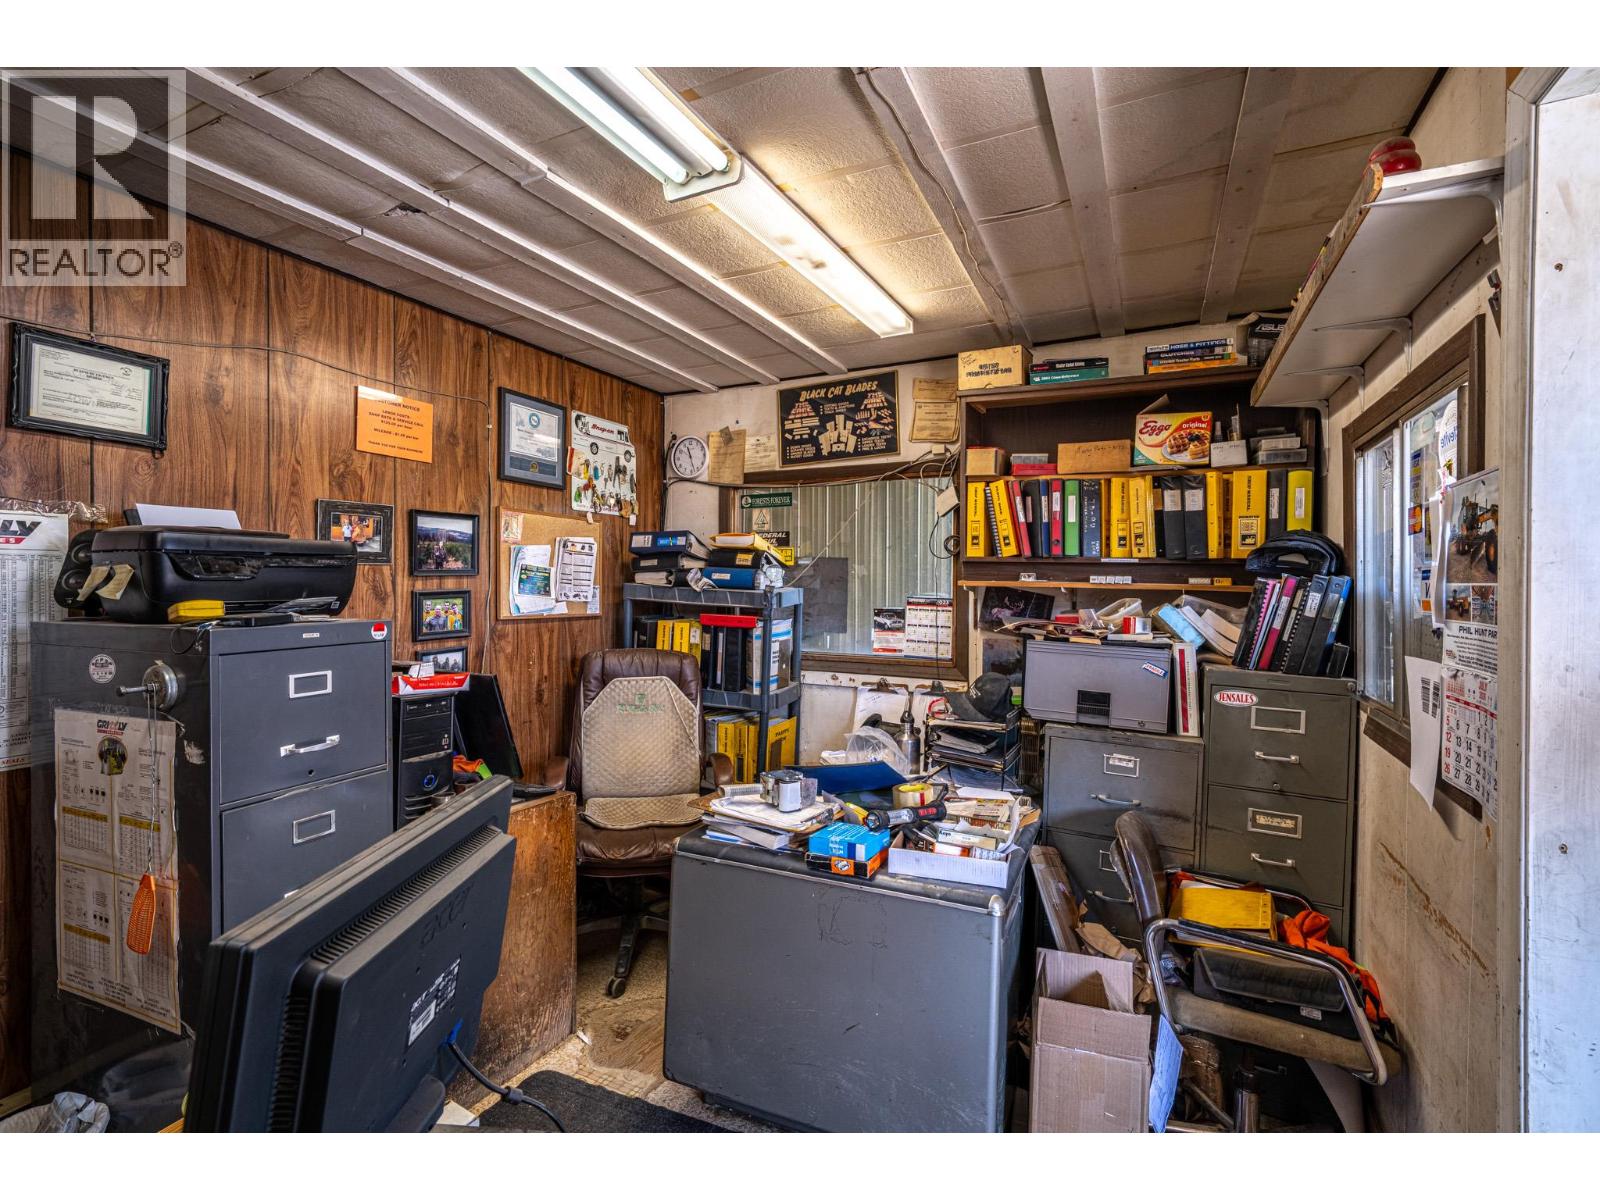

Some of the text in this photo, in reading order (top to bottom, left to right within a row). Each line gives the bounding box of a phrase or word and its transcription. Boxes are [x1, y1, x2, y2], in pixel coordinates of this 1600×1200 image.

[800, 381, 879, 401] BLACK CAT BLADES
[1139, 421, 1172, 436] Eggo
[1459, 626, 1472, 634] PHIL
[1474, 627, 1487, 637] HUNT
[1219, 692, 1254, 703] JENSALES
[1466, 723, 1470, 735] 7
[1446, 732, 1452, 743] 12
[1456, 736, 1461, 747] 13
[1466, 741, 1472, 752] 14
